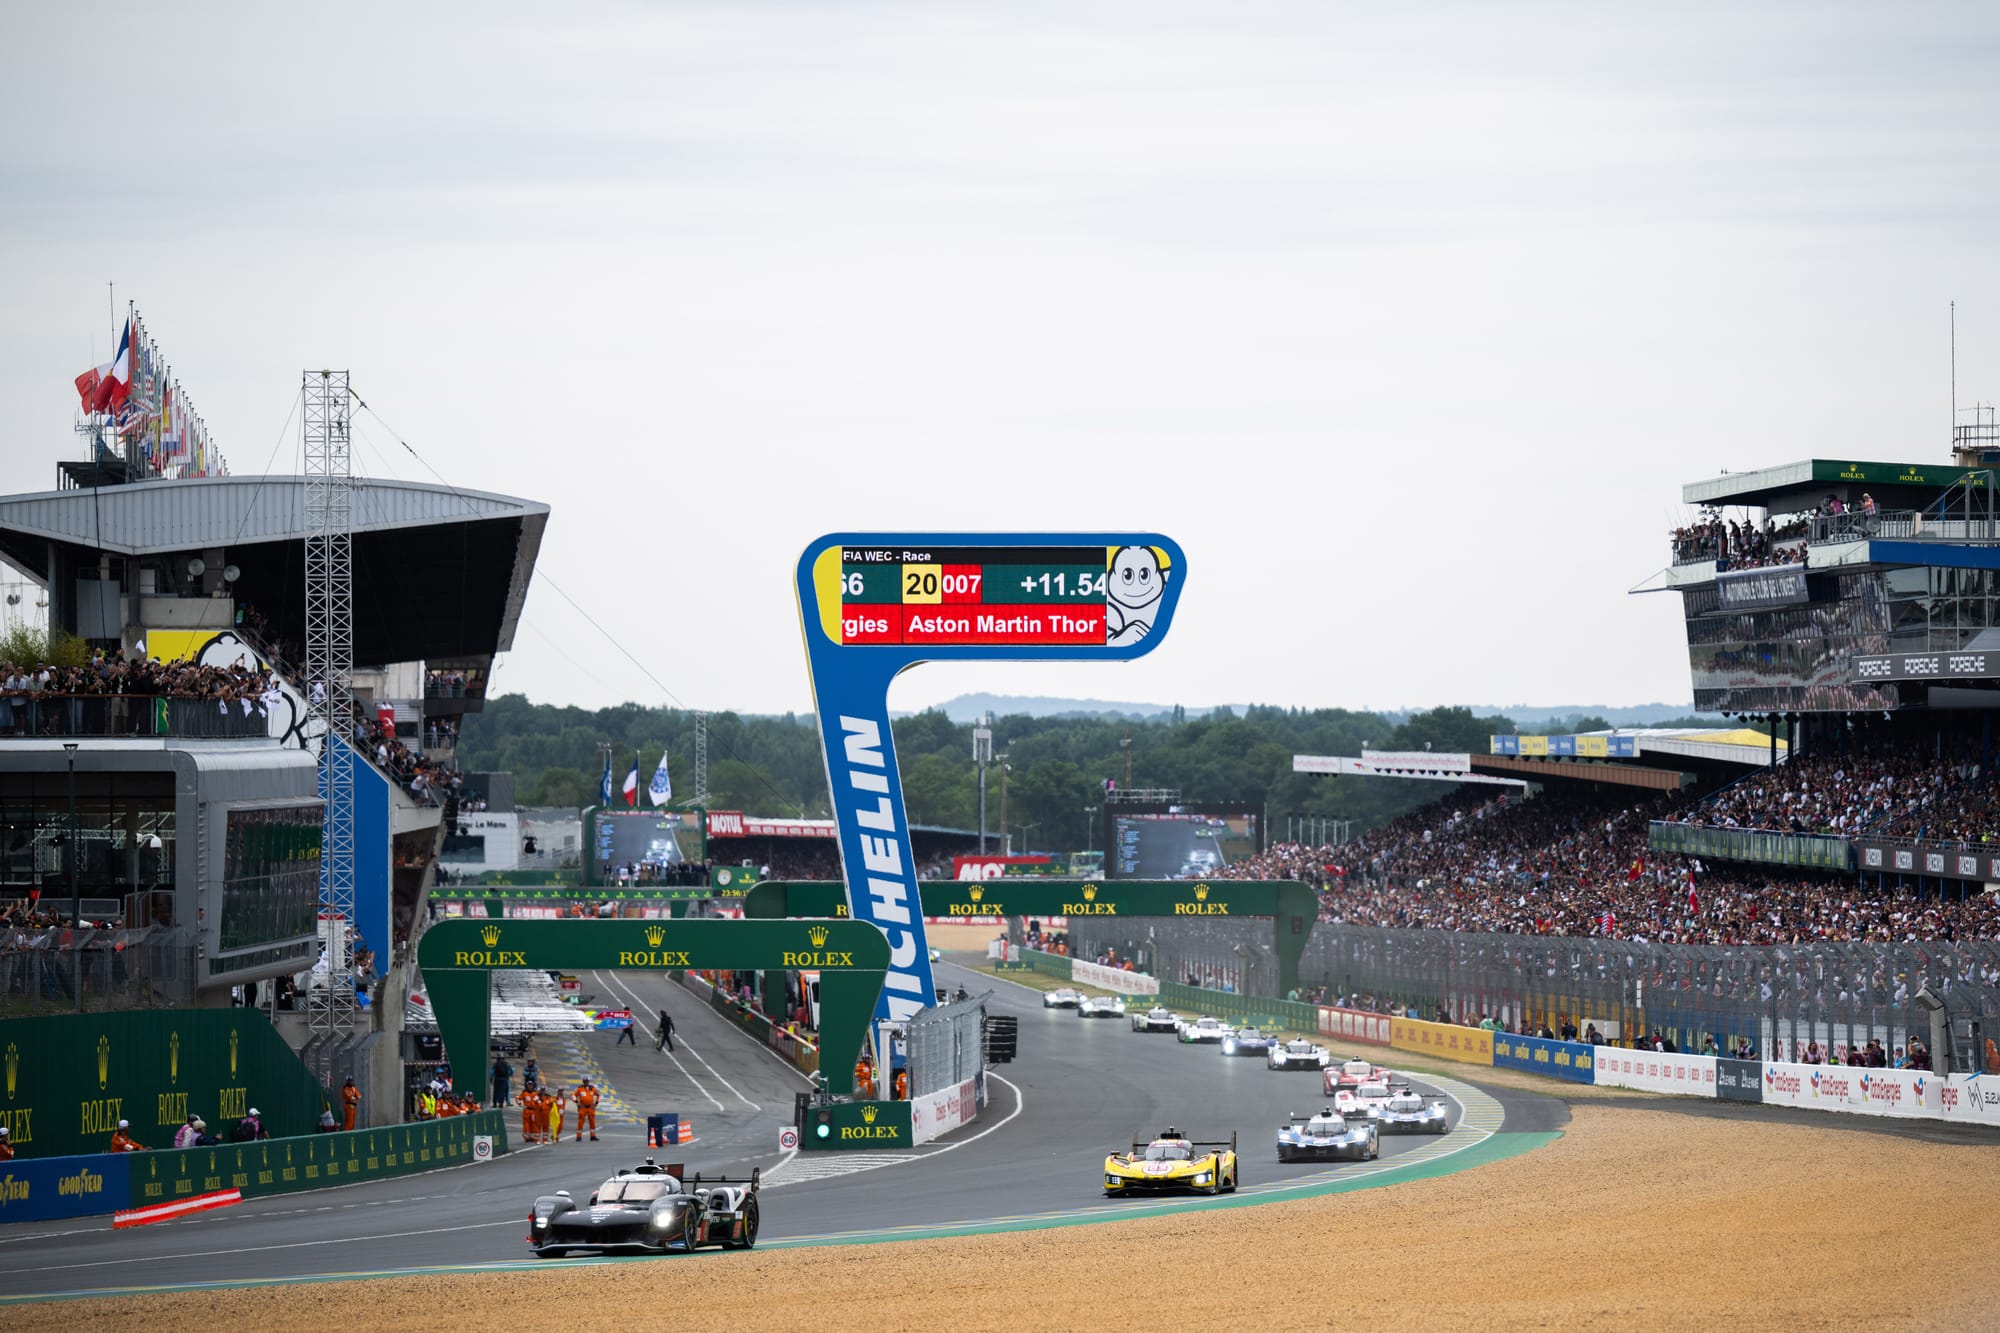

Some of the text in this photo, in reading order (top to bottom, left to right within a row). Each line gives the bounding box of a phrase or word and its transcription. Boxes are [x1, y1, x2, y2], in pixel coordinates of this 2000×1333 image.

[1840, 472, 1865, 480] ROLEX
[1900, 474, 1925, 482] ROLEX
[843, 551, 862, 561] FIA
[865, 551, 892, 561] WEC
[903, 551, 931, 561] Race
[906, 573, 937, 595] 20
[943, 575, 982, 594] 007
[908, 615, 1097, 633] Aston Martin Thor
[1859, 660, 1891, 676] PORSCHE
[1905, 658, 1939, 674] PORSCHE
[1950, 656, 1984, 672] PORSCHE
[711, 815, 743, 833] MOTUL
[950, 903, 1003, 915] ROLEX
[1063, 903, 1116, 915] ROLEX
[1175, 903, 1229, 915] ROLEX
[455, 951, 527, 966] ROLEX
[619, 951, 691, 966] ROLEX
[783, 951, 853, 967] ROLEX
[158, 1092, 188, 1126] ROLEX
[219, 1087, 247, 1120] ROLEX
[81, 1098, 122, 1135] ROLEX
[783, 1136, 794, 1144] 60
[841, 1126, 898, 1138] ROLEX
